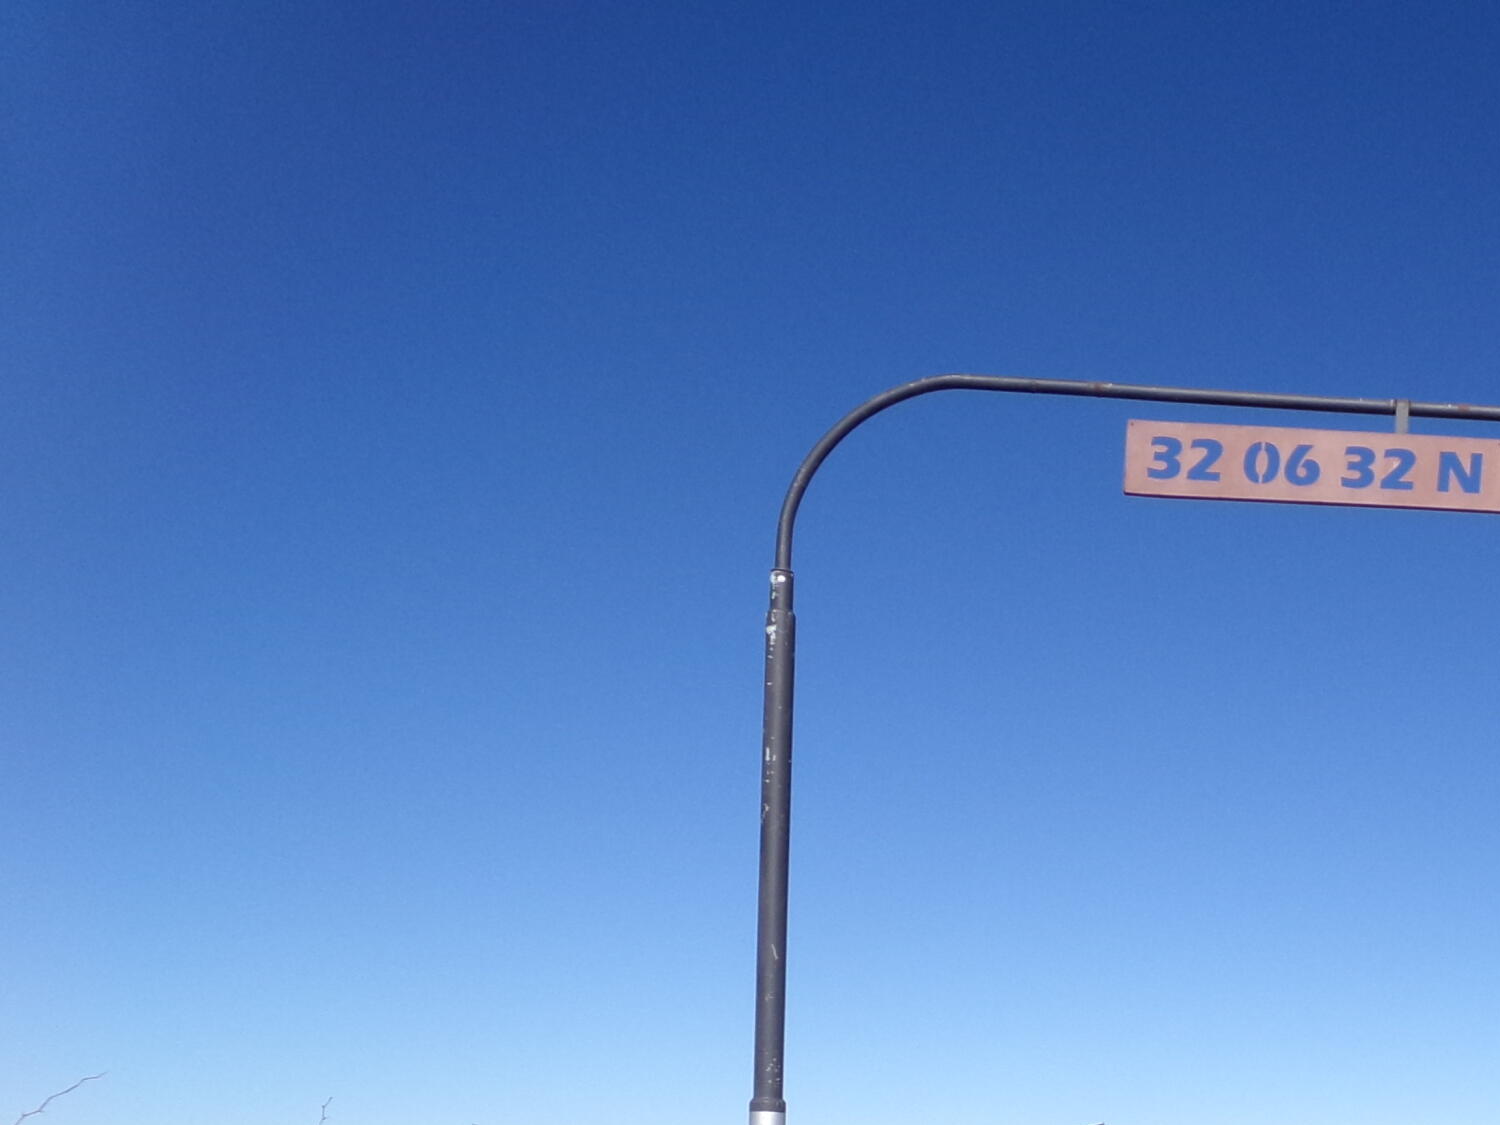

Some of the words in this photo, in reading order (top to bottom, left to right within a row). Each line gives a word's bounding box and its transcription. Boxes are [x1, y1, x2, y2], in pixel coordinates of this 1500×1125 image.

[1146, 437, 1222, 482] 32
[1243, 441, 1320, 486] 06
[1340, 446, 1415, 491] 32
[1437, 452, 1483, 494] N
